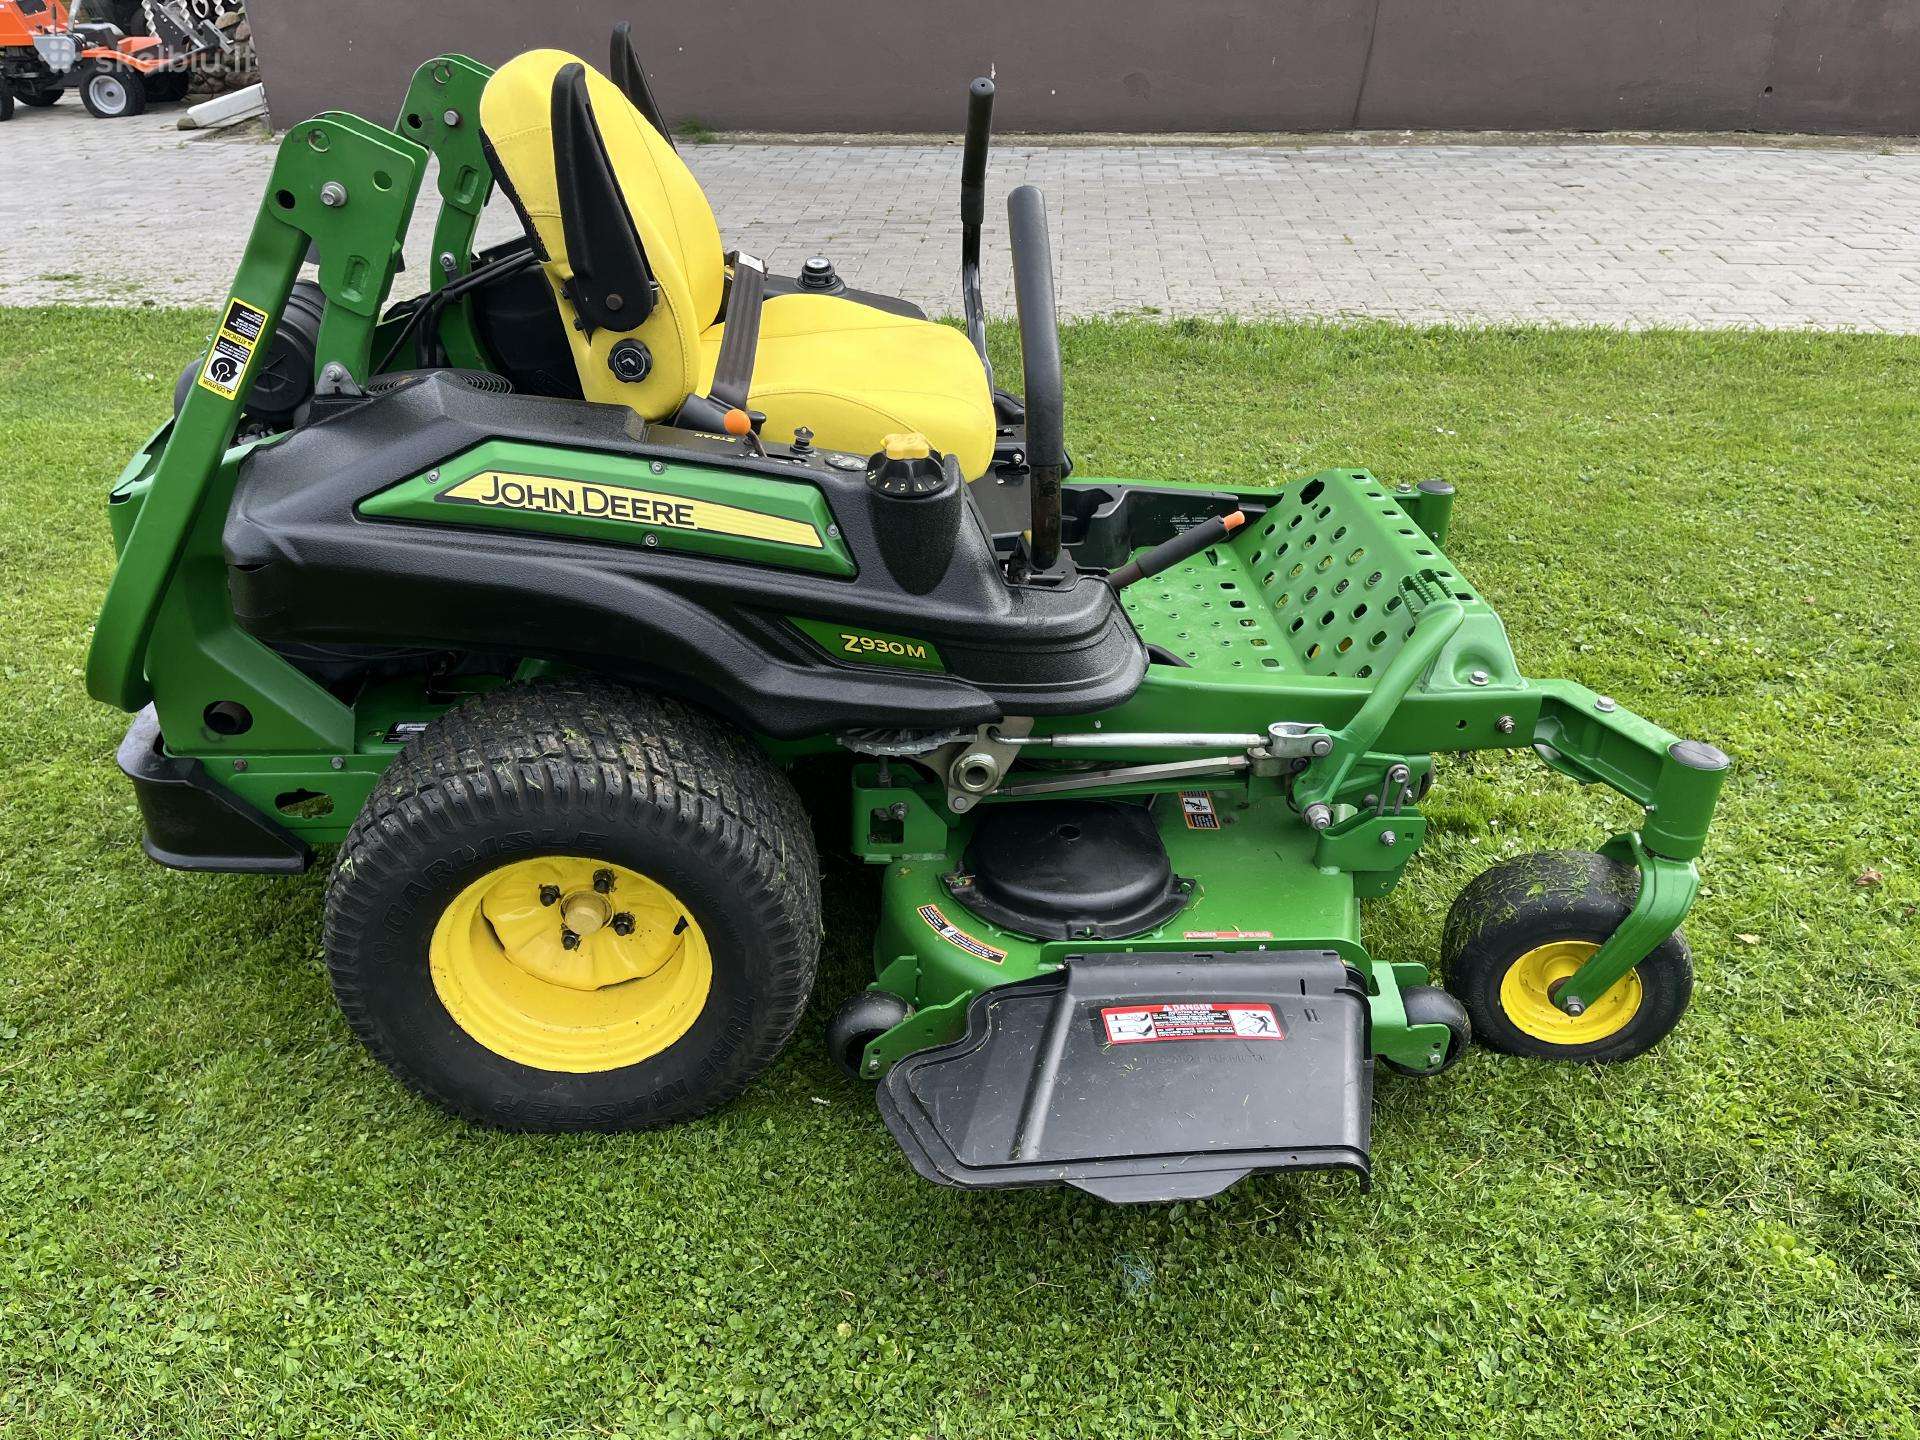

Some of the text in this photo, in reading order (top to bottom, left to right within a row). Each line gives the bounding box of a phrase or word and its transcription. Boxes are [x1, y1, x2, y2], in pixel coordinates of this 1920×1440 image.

[481, 475, 695, 527] JOHN DEERE
[840, 634, 927, 659] Z930M
[1173, 1003, 1214, 1011] DANGER
